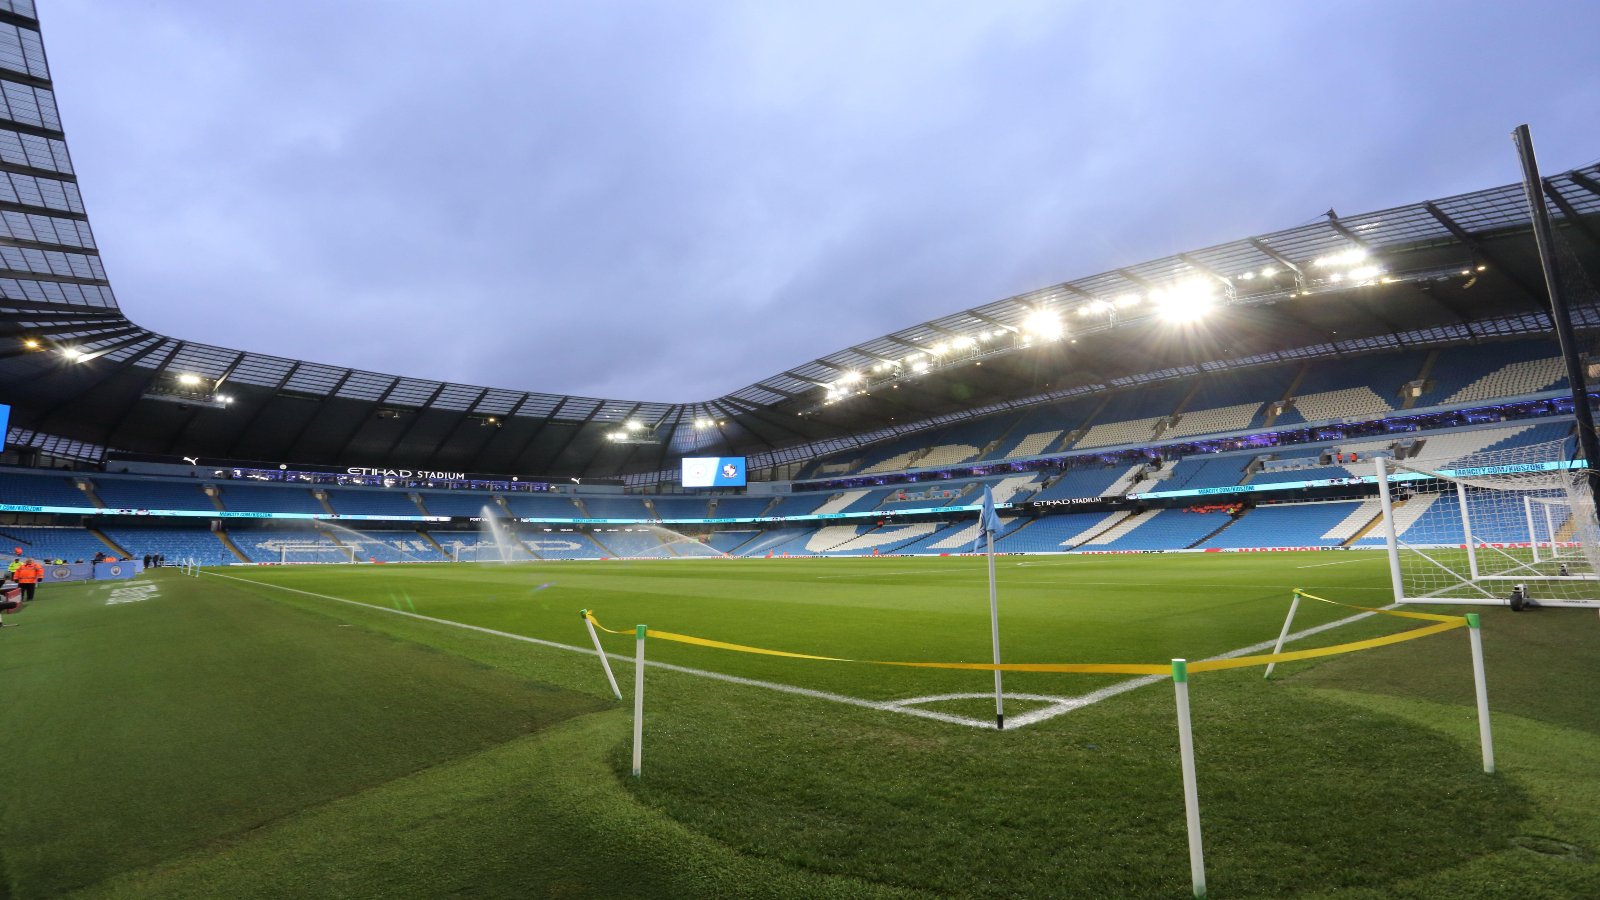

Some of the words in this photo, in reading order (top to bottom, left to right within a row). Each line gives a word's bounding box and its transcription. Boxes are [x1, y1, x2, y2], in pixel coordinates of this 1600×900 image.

[347, 467, 413, 478] ETIHAD
[417, 471, 465, 480] STADIUM
[1033, 499, 1070, 507] ETIHAD
[1072, 497, 1102, 505] STADIUM
